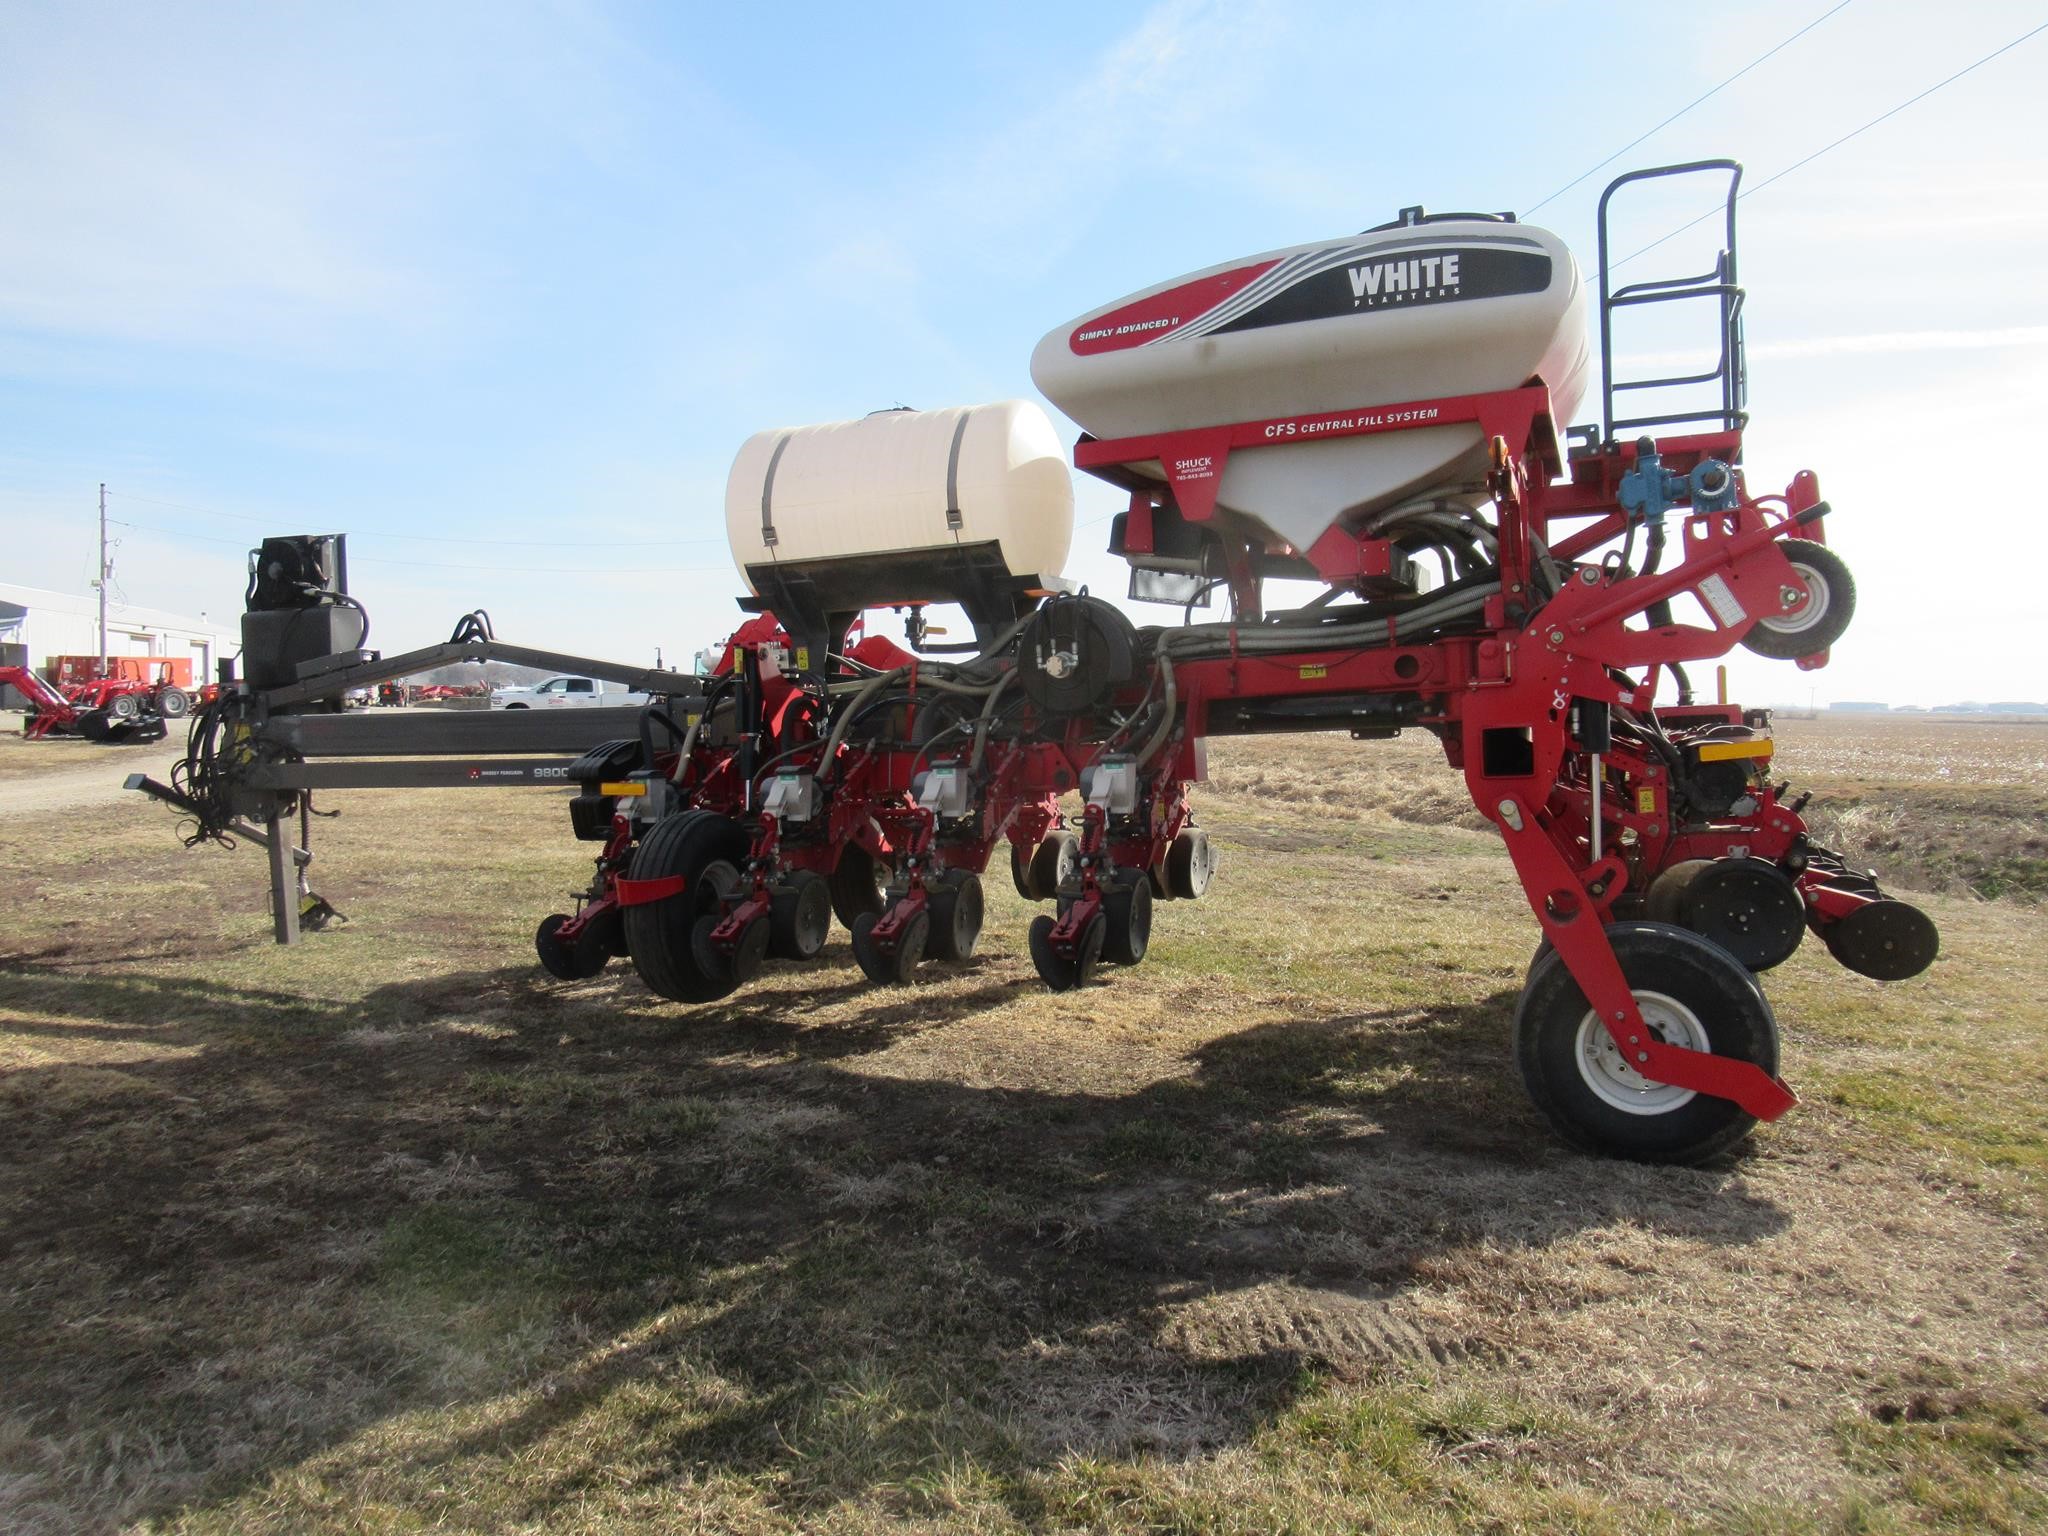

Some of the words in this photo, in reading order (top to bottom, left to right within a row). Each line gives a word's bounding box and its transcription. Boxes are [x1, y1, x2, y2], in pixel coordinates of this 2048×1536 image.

[1348, 254, 1460, 298] WHITE
[1354, 287, 1460, 307] PLANTERS
[1079, 328, 1114, 341] SIMPLY
[1115, 318, 1169, 334] ADVANCED
[1171, 317, 1179, 326] II
[1265, 423, 1296, 438] CFS
[1301, 419, 1354, 433] CENTRAL
[1358, 415, 1383, 427] FILL
[1387, 408, 1438, 423] SYSTEM
[1175, 456, 1212, 470] SHUCK
